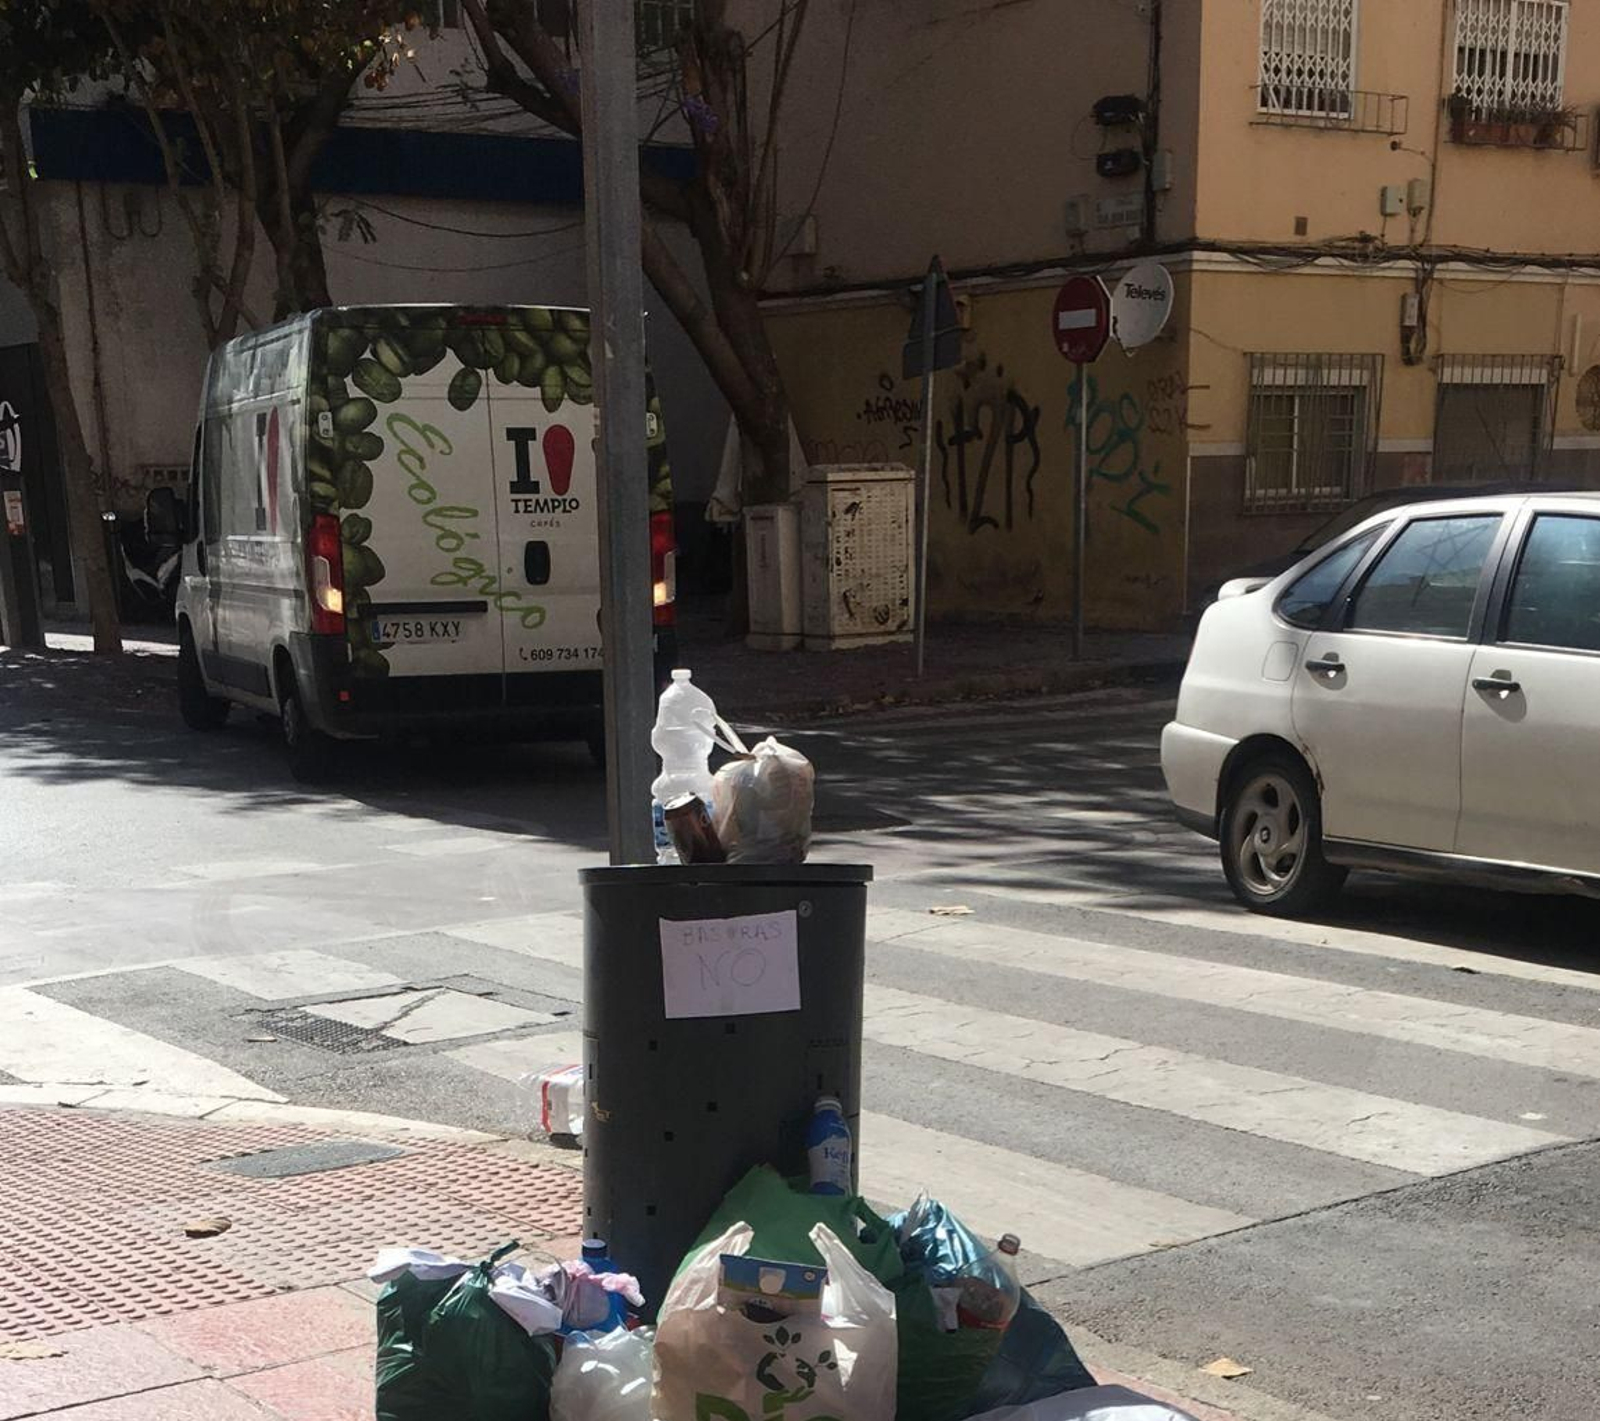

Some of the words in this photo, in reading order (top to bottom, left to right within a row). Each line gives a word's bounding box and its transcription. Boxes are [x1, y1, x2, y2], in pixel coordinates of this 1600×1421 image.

[506, 427, 540, 494] I
[511, 498, 580, 513] TEMPLO
[383, 622, 424, 638] 4758
[430, 621, 460, 637] KXY
[531, 648, 552, 660] 609
[557, 648, 579, 660] 734
[699, 948, 766, 990] NO
